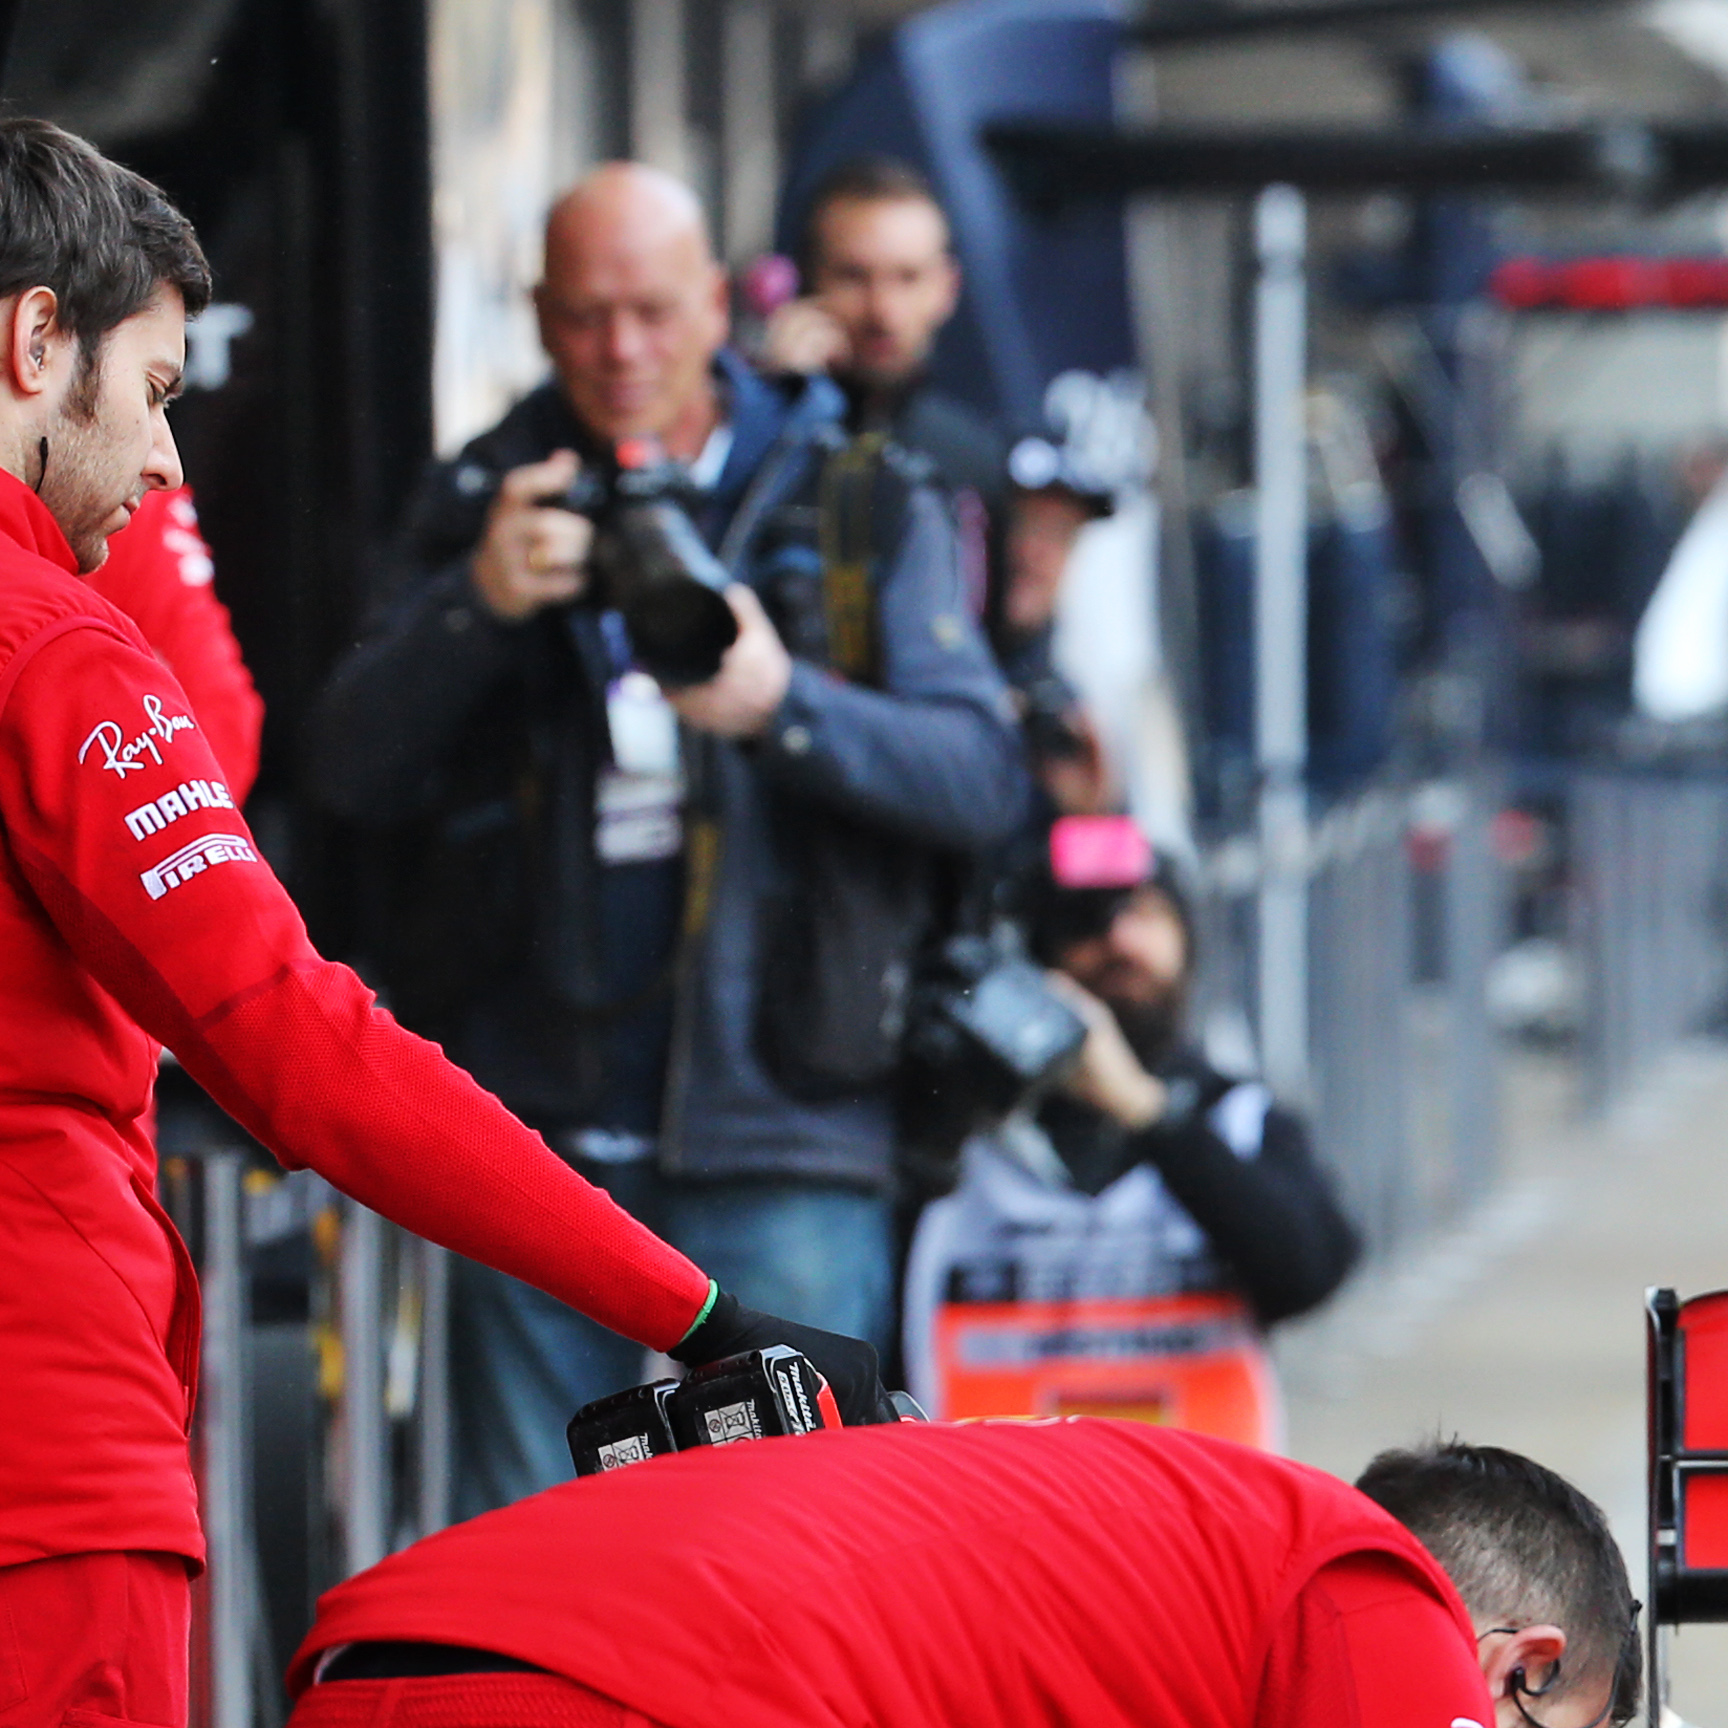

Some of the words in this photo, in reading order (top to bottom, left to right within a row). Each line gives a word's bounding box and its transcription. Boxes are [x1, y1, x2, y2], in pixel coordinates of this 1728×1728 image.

[78, 694, 195, 779] Ray-Ban
[124, 780, 235, 842] MAHLE
[140, 833, 258, 900] PIRELLI
